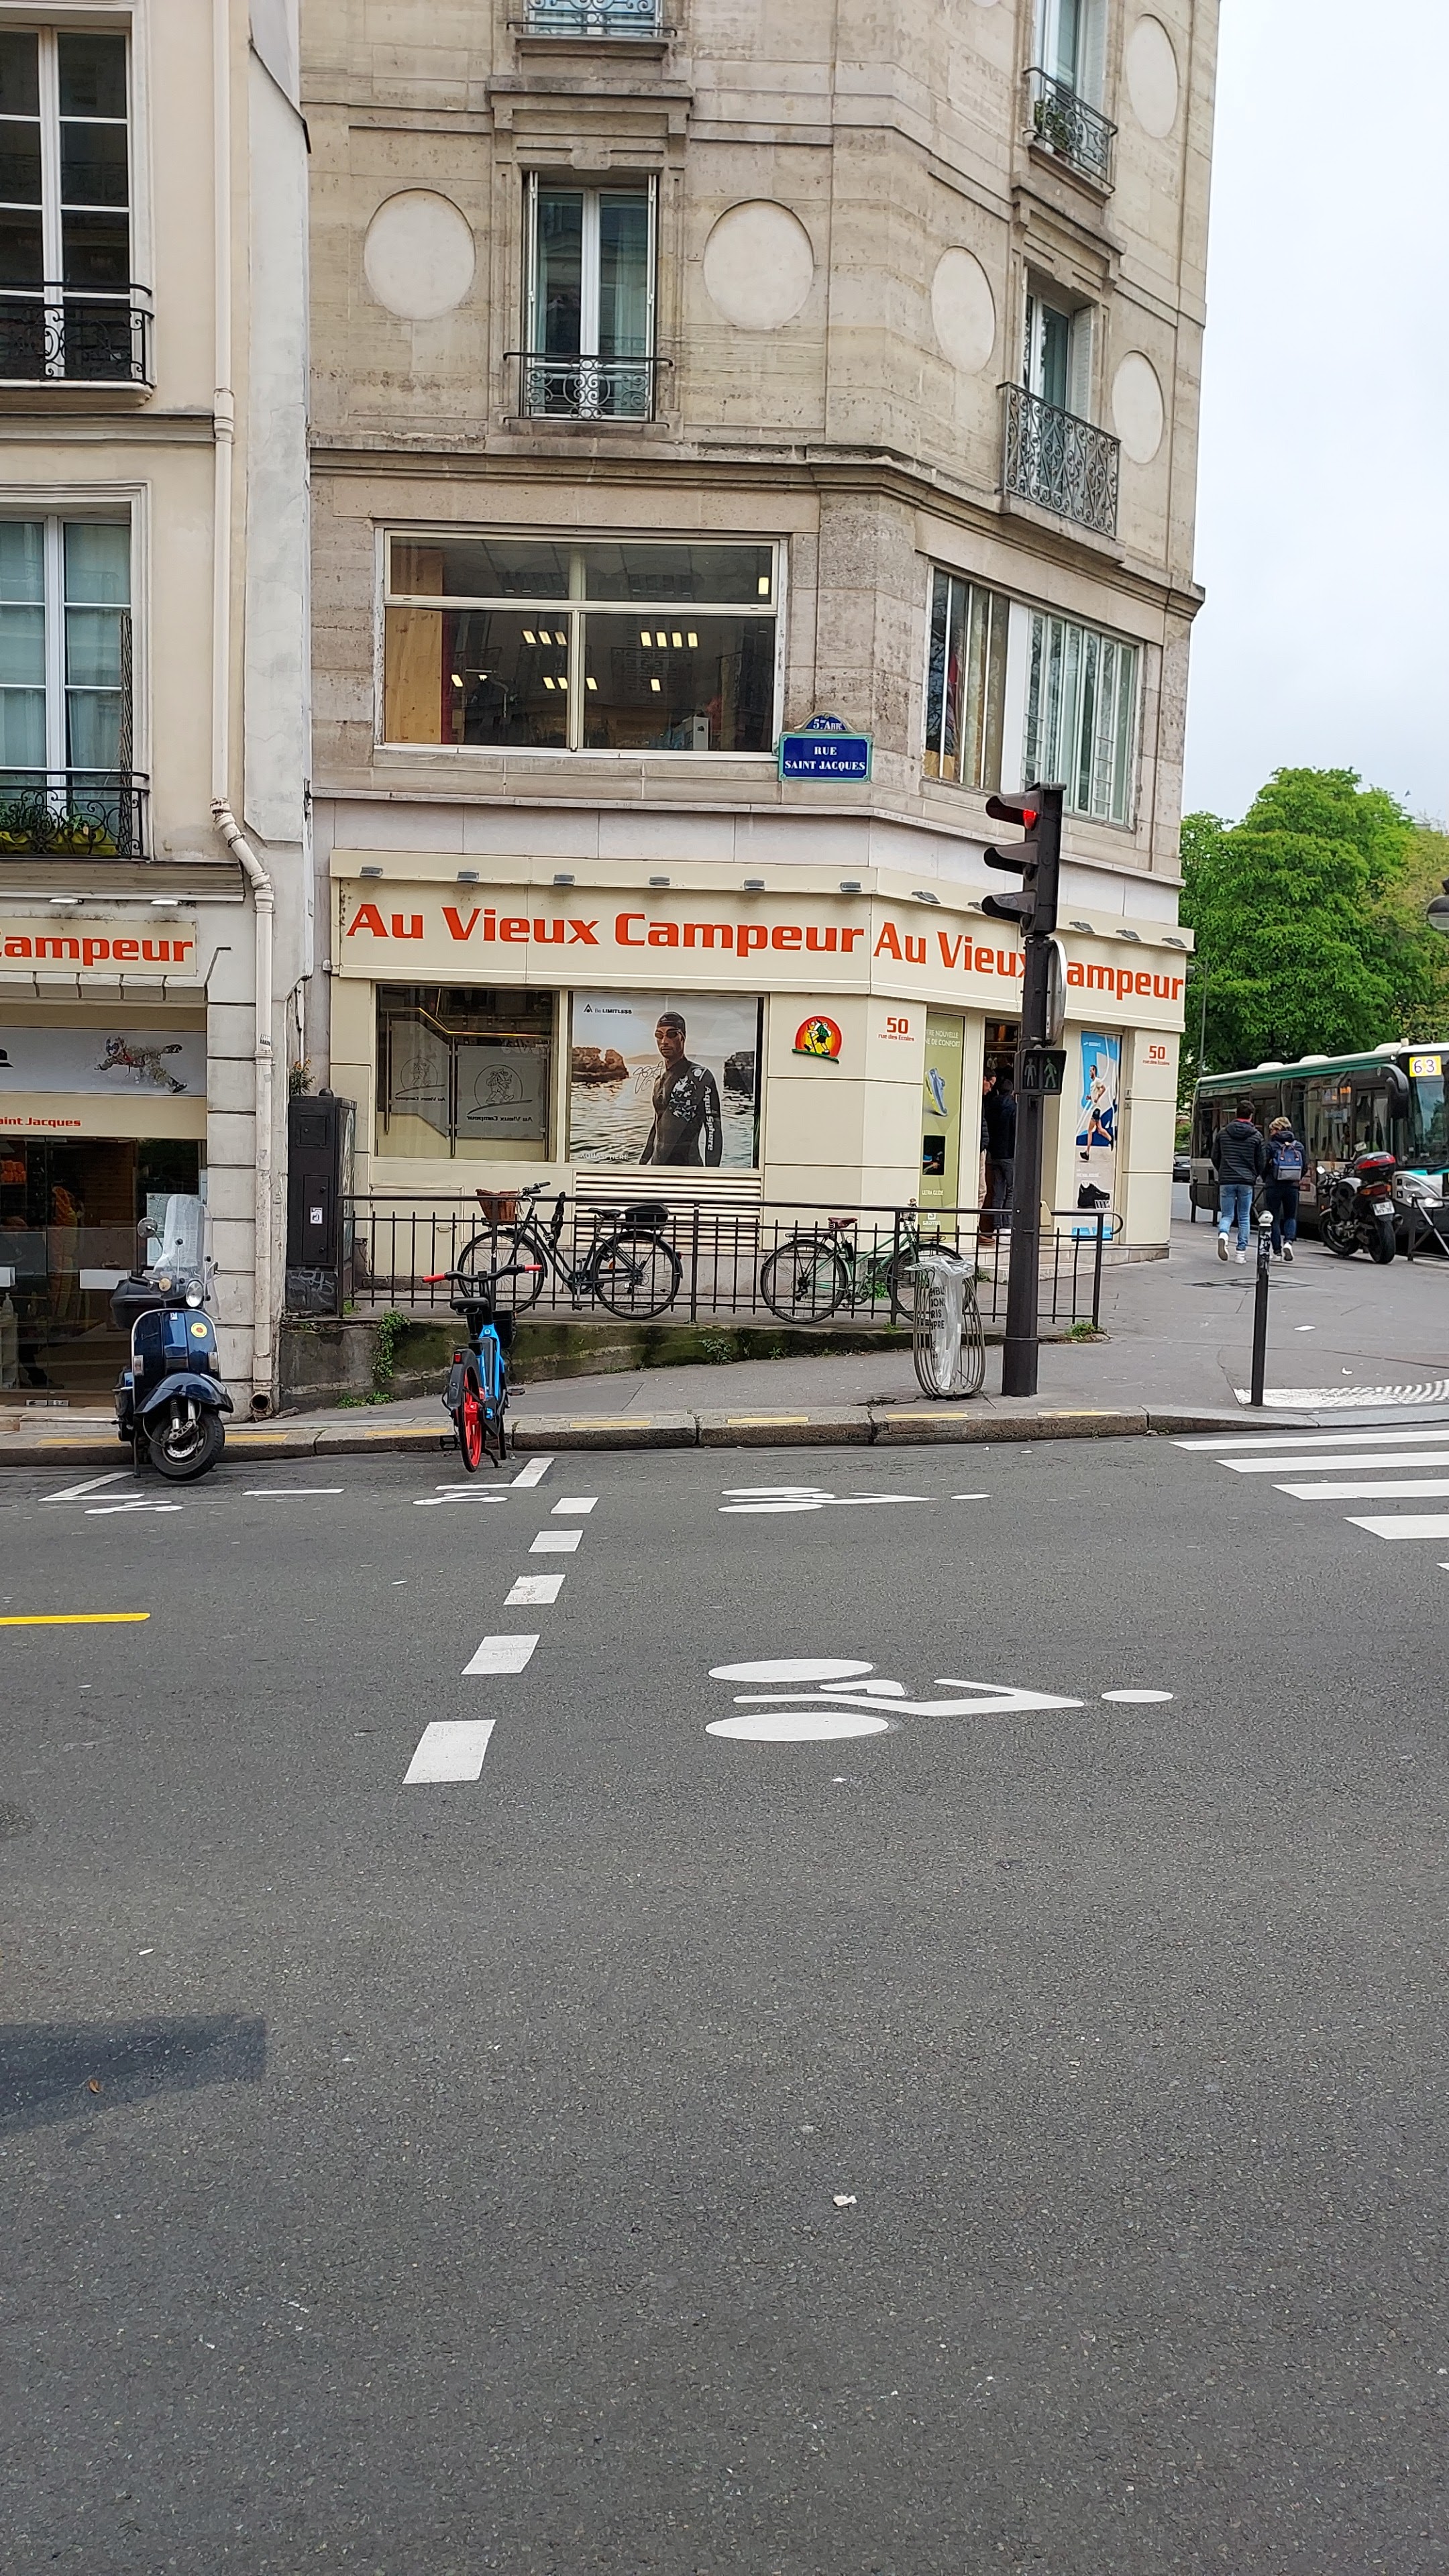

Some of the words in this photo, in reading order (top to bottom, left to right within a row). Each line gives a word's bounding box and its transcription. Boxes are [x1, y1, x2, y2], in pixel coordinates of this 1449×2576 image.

[814, 747, 837, 755] RUE
[785, 761, 816, 769] SAINT
[819, 761, 865, 771] JACQUES
[346, 904, 424, 940] Au
[442, 907, 599, 945] Vieux
[614, 913, 865, 958] Campeur
[0, 931, 193, 967] ampeur
[873, 922, 926, 965] Au
[1067, 961, 1184, 1001] ampeur
[886, 1017, 909, 1034] 50
[938, 1039, 961, 1047] CONFORT
[1149, 1046, 1165, 1059] 50
[1413, 1060, 1435, 1073] 63
[703, 1085, 711, 1114] Aqua
[0, 1116, 23, 1125] aint
[25, 1118, 81, 1128] Jacques
[706, 1116, 715, 1151] Sphere
